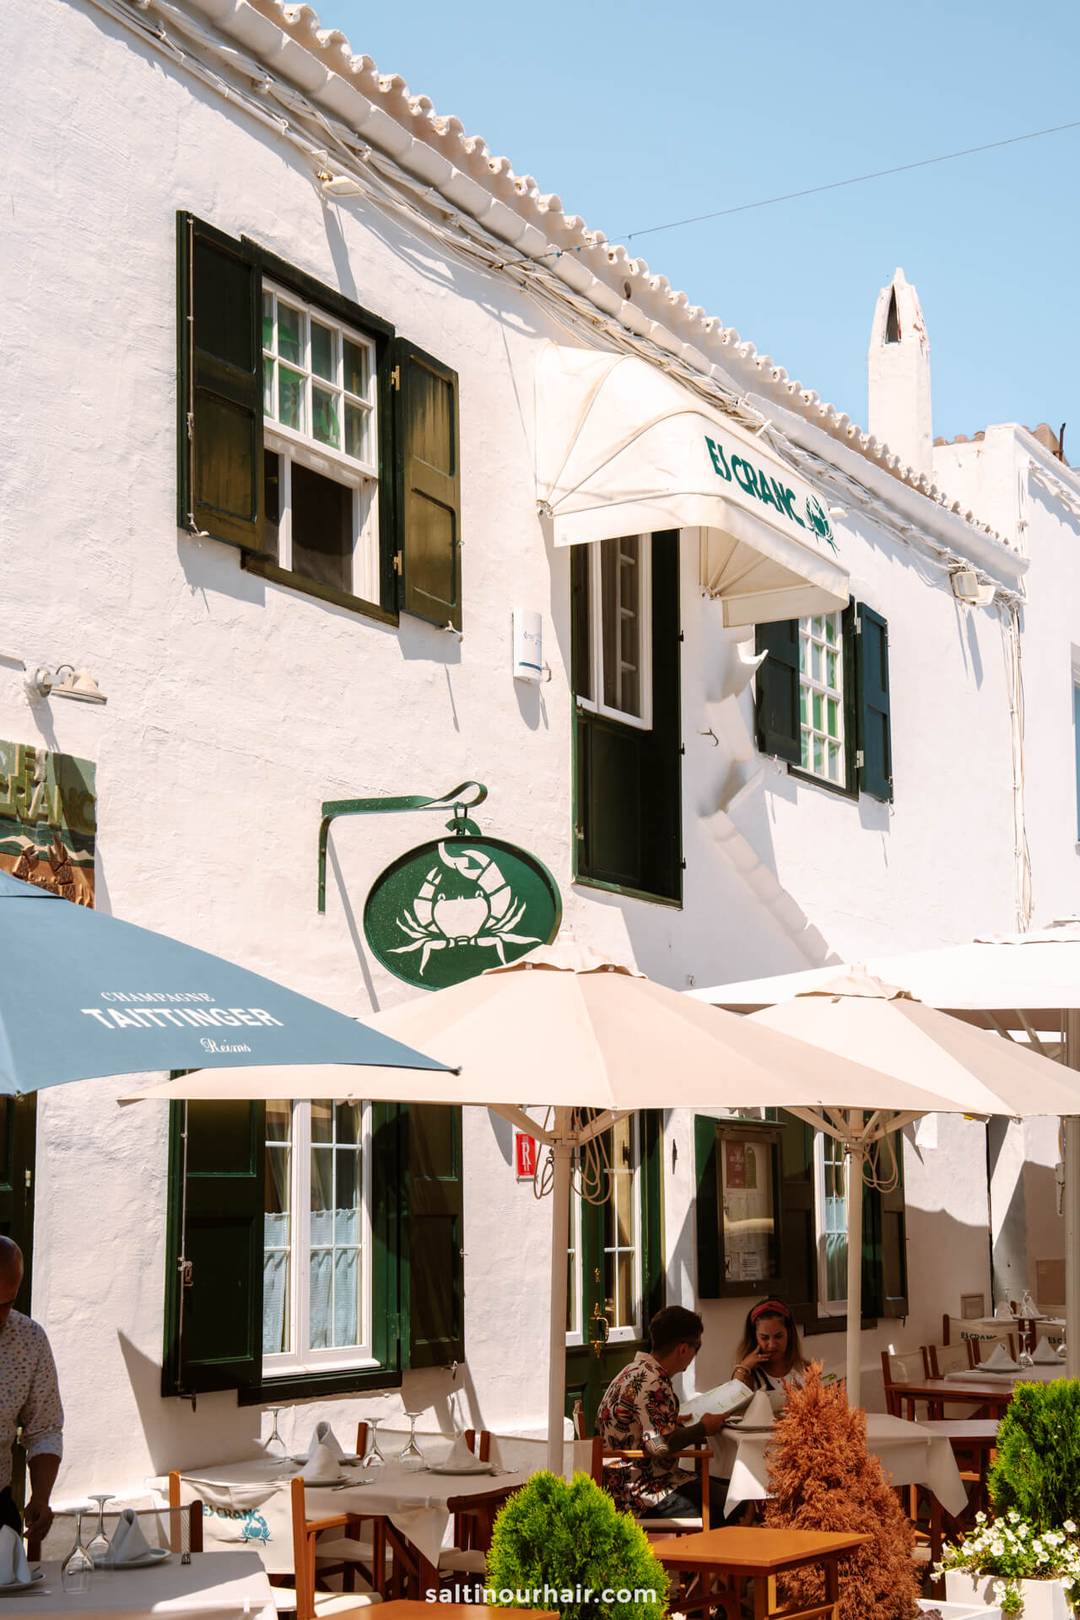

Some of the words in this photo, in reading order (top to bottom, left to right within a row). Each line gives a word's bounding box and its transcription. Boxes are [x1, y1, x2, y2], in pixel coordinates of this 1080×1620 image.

[731, 454, 806, 528] CRANC
[100, 991, 216, 1002] CHAMPAGNE
[80, 1008, 285, 1029] TAITTINGER
[200, 1037, 252, 1053] Reims
